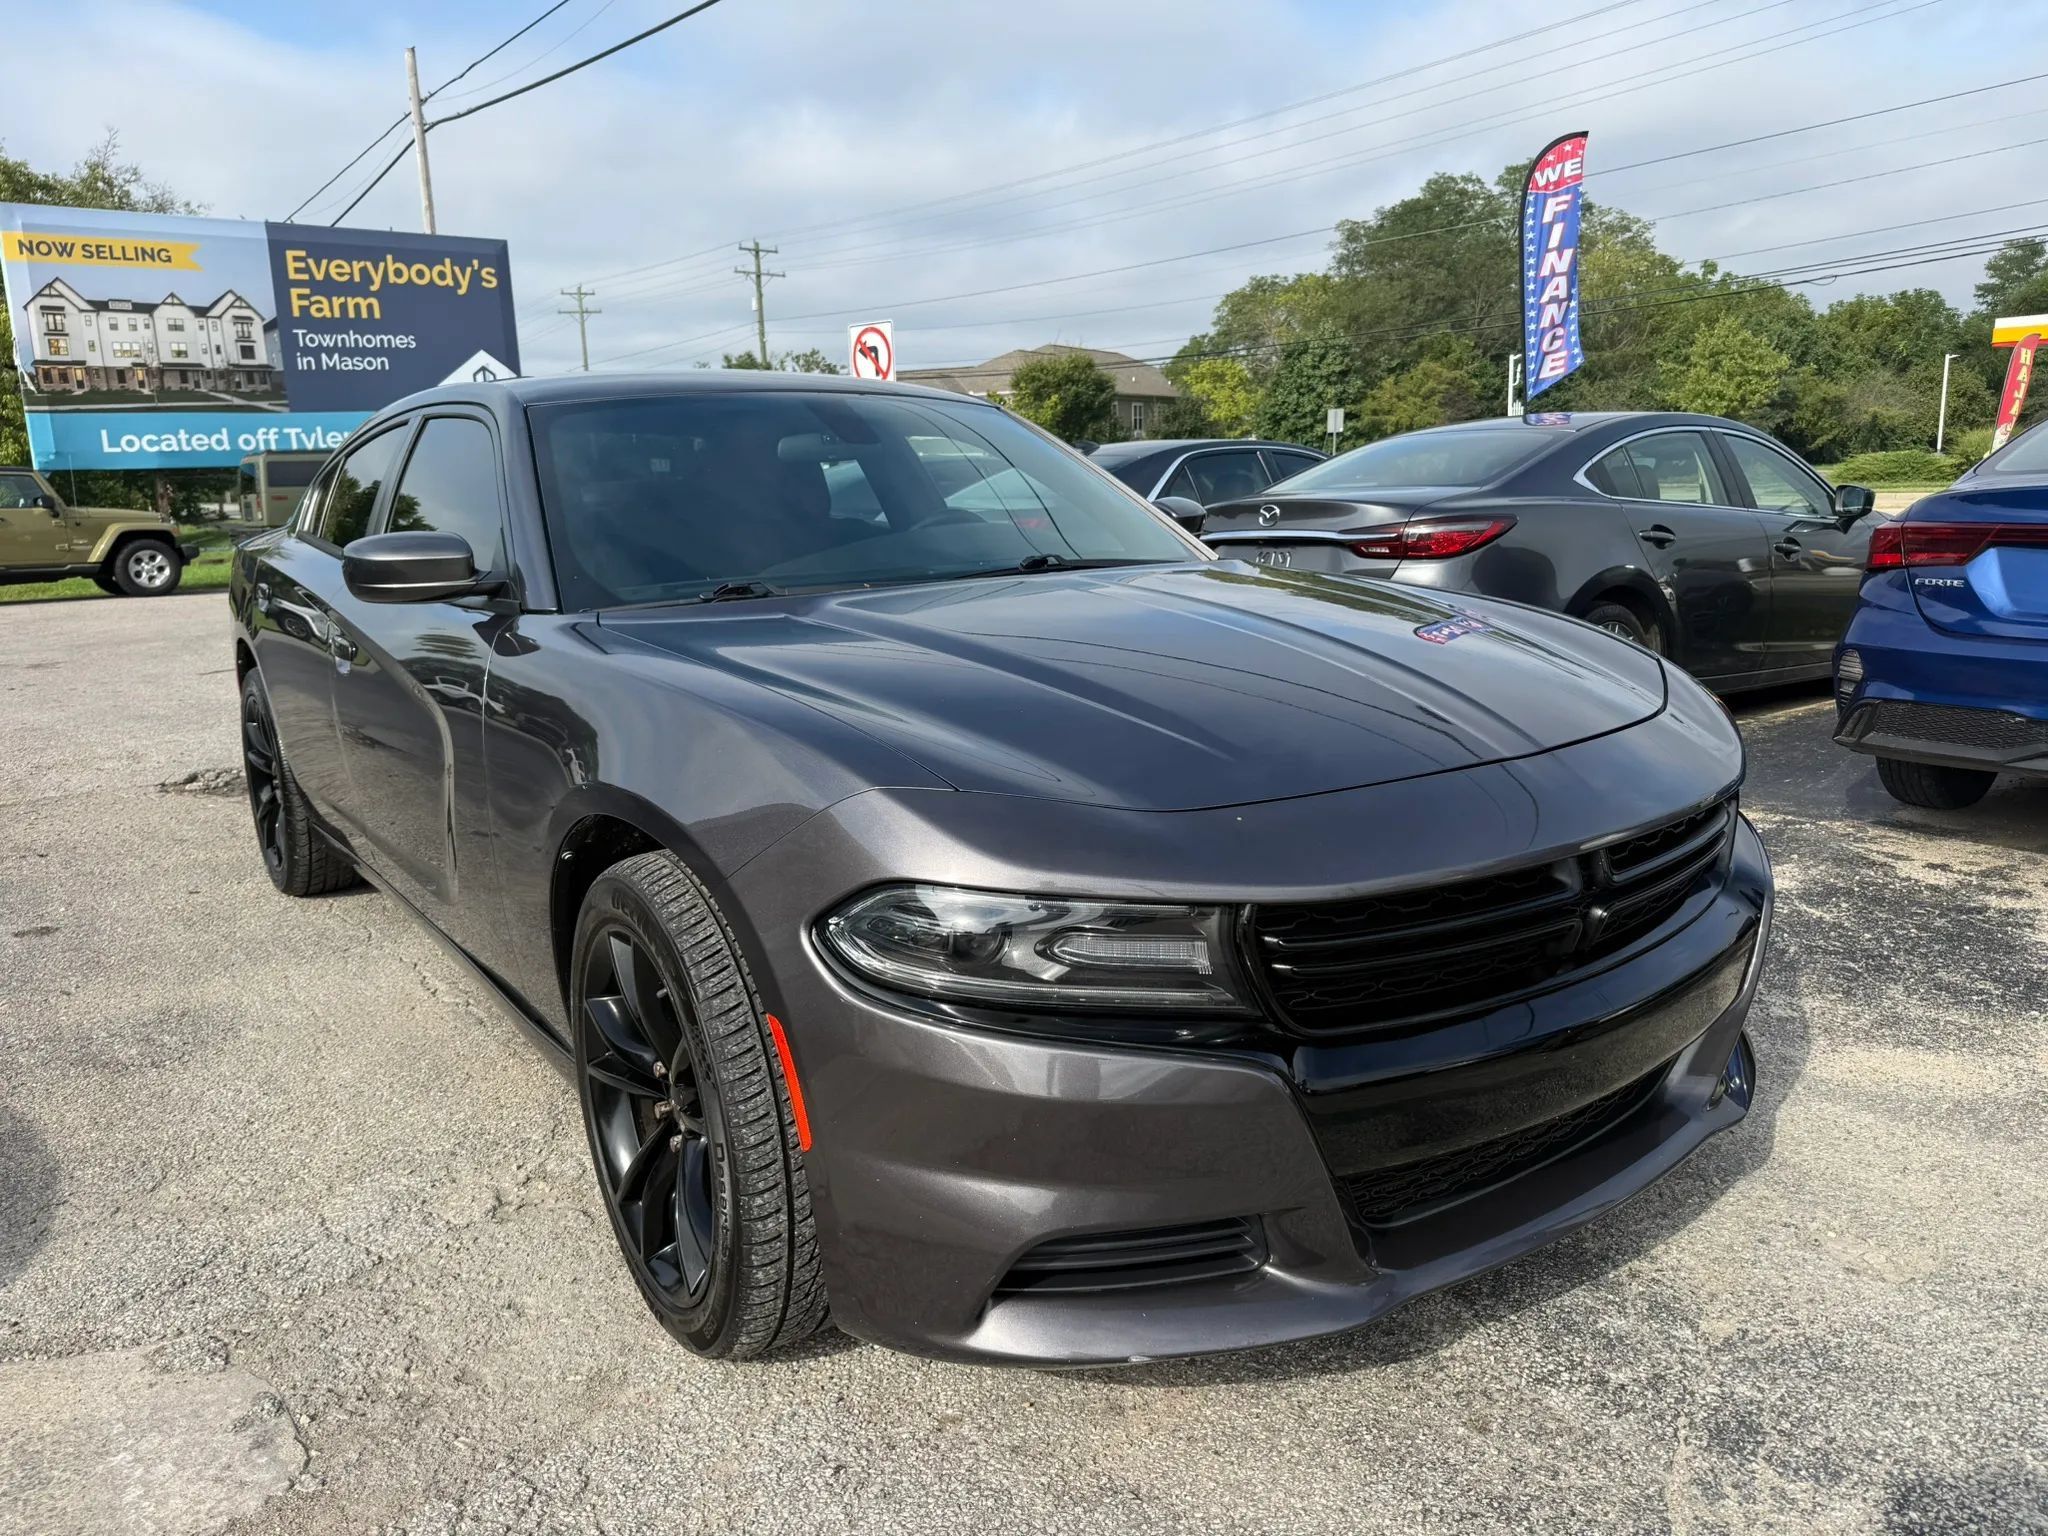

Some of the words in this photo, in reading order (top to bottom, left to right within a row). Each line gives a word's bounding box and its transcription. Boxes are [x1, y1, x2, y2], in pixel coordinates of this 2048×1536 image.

[1534, 157, 1582, 188] WE
[17, 239, 76, 258] NOW
[81, 243, 173, 263] SELLING
[285, 249, 499, 296] Everybody's
[1539, 194, 1574, 379] FINANCE
[289, 287, 382, 320] Farm
[292, 329, 417, 349] Townhomes
[296, 352, 316, 371] in
[321, 352, 390, 371] Mason
[101, 427, 231, 453] Located
[237, 427, 279, 451] off
[1914, 577, 1965, 588] FORTE
